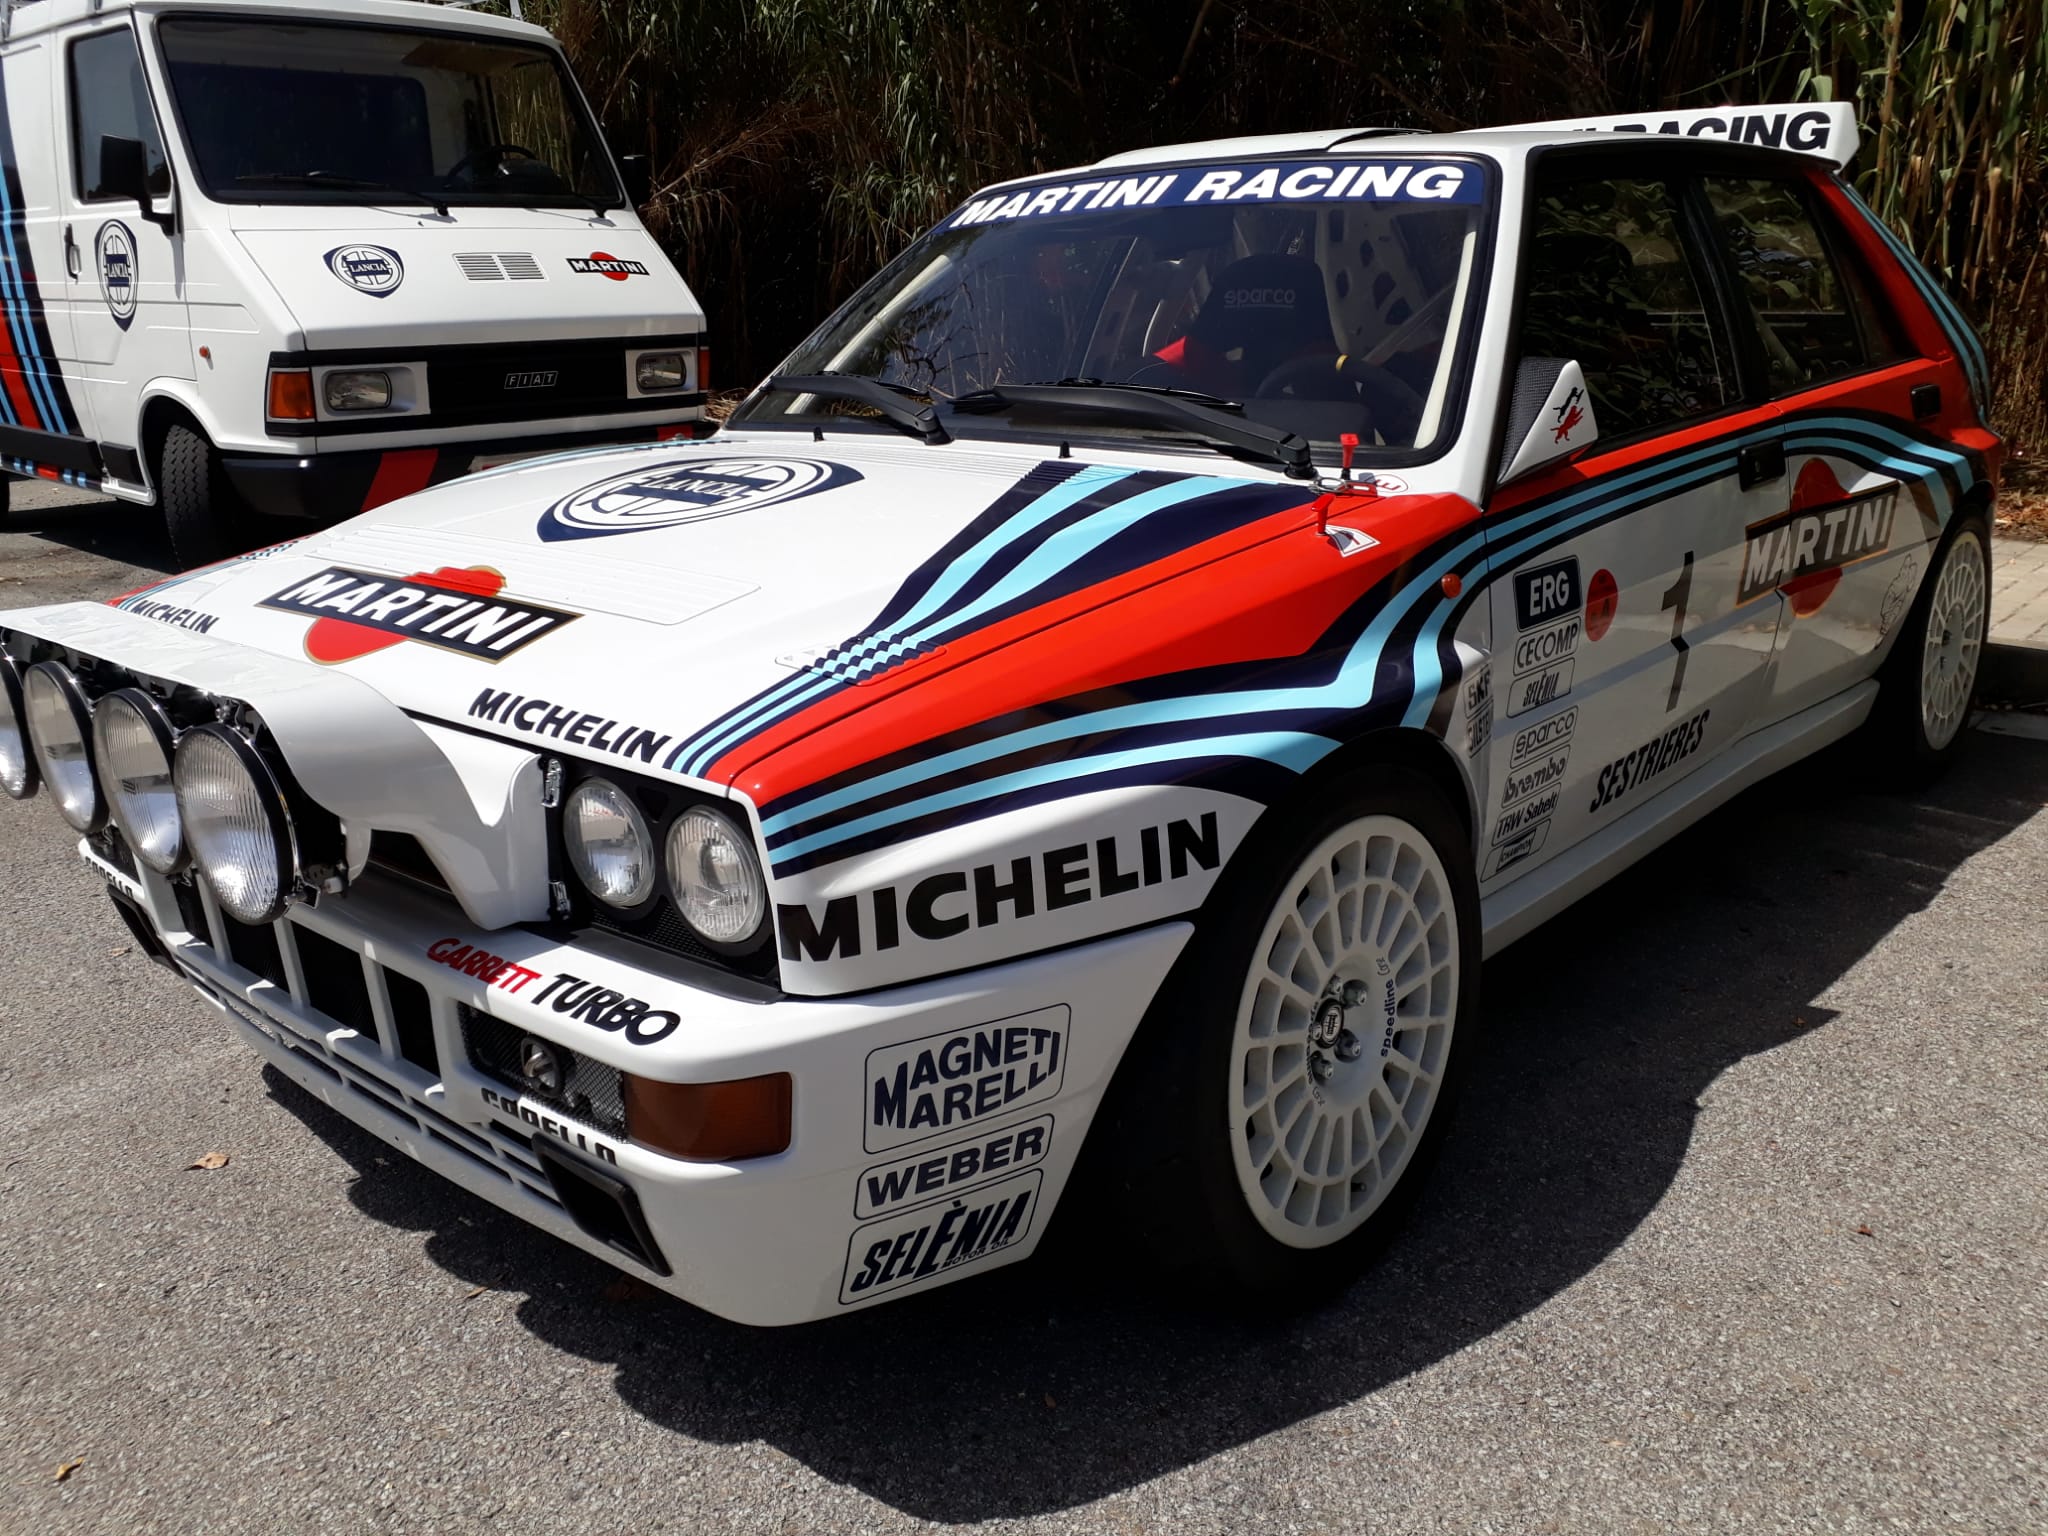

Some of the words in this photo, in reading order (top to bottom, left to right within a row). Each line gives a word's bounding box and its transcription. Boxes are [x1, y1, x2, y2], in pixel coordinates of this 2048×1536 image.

[948, 174, 1179, 229] MARTINI
[1184, 165, 1465, 202] RACING
[350, 263, 388, 273] LANCIA
[570, 259, 648, 274] MARTINI
[1223, 287, 1296, 308] sparco
[508, 373, 555, 386] FIAT
[1743, 495, 1894, 592] MARTINI
[131, 600, 219, 634] MICHELIN
[278, 573, 555, 651] MARTINI
[1529, 570, 1570, 617] ERG
[1517, 622, 1578, 668] CECOMP
[1661, 550, 1694, 713] 1
[1468, 668, 1491, 711] SKF
[468, 687, 672, 763] MICHELIN
[1514, 711, 1575, 758] sparco
[1503, 756, 1566, 804] brembo
[1589, 708, 1711, 813] SESTRIERES
[1497, 808, 1525, 837] TRW
[1524, 793, 1558, 823] Sabelt
[775, 811, 1221, 963] MICHELIN
[426, 937, 543, 994] GARRETT
[530, 972, 681, 1045] TURBO
[1381, 978, 1396, 1057] speedline
[874, 1027, 1061, 1118] MAGNETI
[874, 1042, 1061, 1129] MARELLI
[867, 1125, 1044, 1208] WEBER
[849, 1190, 1032, 1293] SELÈNIA
[941, 1247, 986, 1269] MOTOR
[991, 1239, 1009, 1250] OIL
